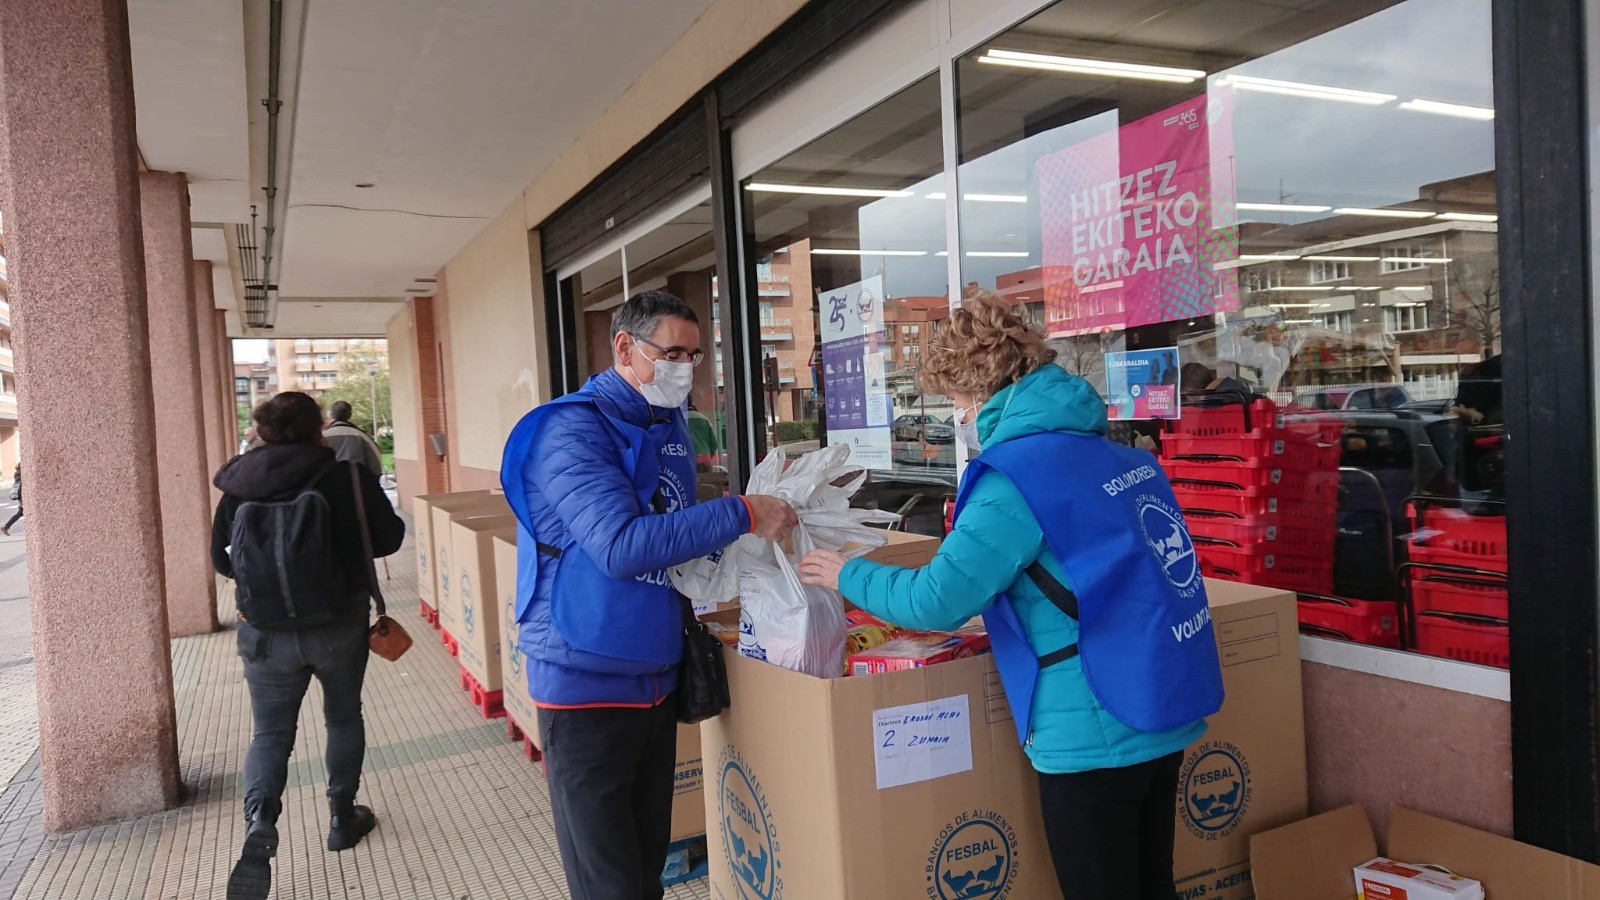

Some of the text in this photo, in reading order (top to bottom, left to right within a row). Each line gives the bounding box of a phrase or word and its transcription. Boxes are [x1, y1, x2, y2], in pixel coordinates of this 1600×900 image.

[1180, 108, 1197, 124] 365
[1070, 160, 1177, 222] HITZEZ
[1072, 191, 1200, 255] EKITEKO
[1073, 233, 1193, 287] GARAIA
[1108, 359, 1149, 368] EUSKARALDIA
[883, 729, 896, 748] 2
[1200, 742, 1211, 754] DE
[1213, 740, 1251, 776] ALIMENTOS
[1193, 766, 1235, 787] FESBAL
[725, 786, 762, 835] FESBAL
[926, 809, 1018, 873] BANCOS DE ALIMENTOS
[946, 838, 999, 863] FESBAL
[1207, 831, 1218, 841] DE
